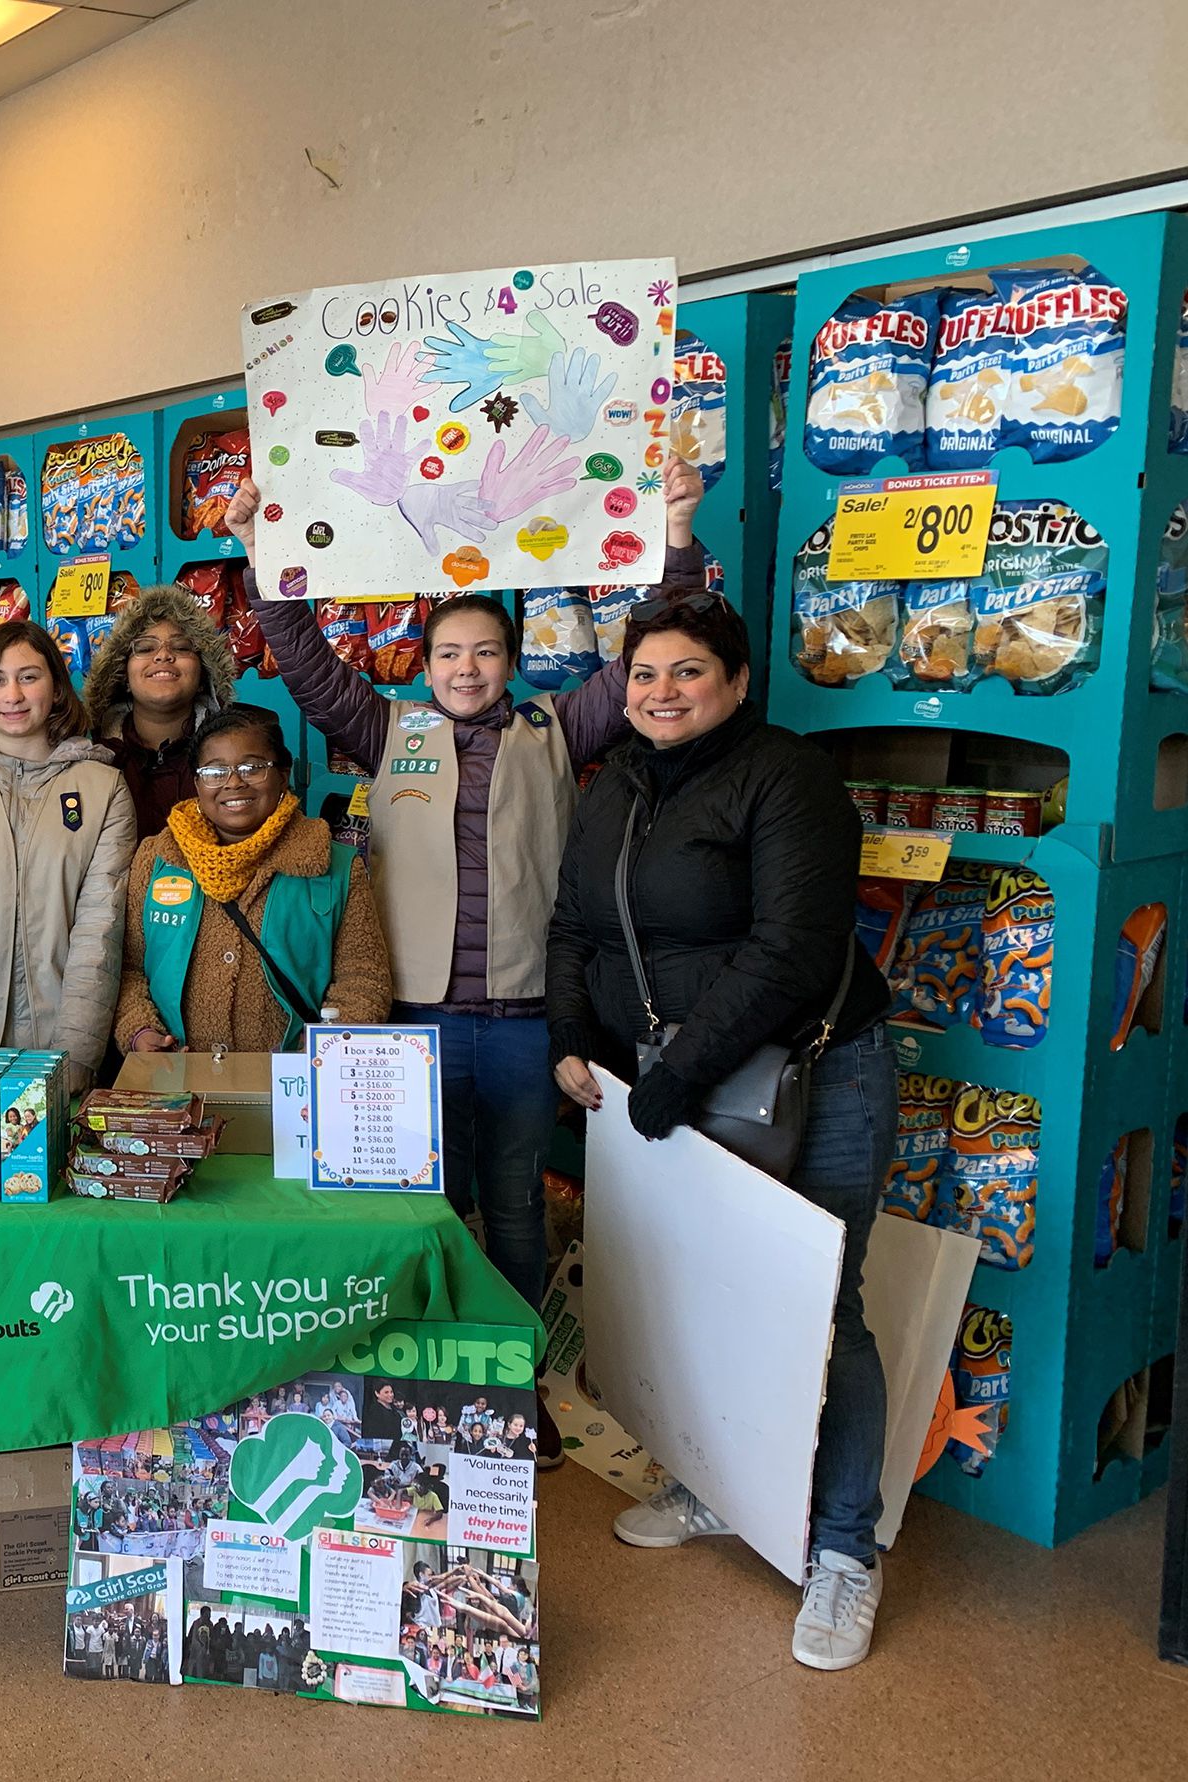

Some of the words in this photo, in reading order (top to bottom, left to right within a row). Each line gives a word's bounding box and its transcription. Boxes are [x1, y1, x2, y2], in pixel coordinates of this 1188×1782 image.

[322, 285, 471, 340] Cookies
[534, 267, 603, 310] Sale
[816, 312, 928, 360] RUFFLES
[1028, 350, 1063, 373] Party
[1063, 340, 1088, 357] Size!
[837, 363, 867, 382] Party
[867, 358, 893, 374] Size!
[950, 364, 977, 382] Party
[978, 354, 1003, 371] Size!
[608, 409, 632, 418] WOW!
[1030, 428, 1093, 444] ORIGINAL
[828, 436, 886, 453] ORIGINAL
[940, 436, 996, 453] ORIGINAL
[201, 453, 247, 477] Doritos
[888, 478, 921, 490] BONUS
[923, 476, 959, 487] TICKET
[960, 474, 985, 485] ITEM
[842, 497, 889, 514] Sale!
[59, 567, 76, 578] Sale!
[985, 582, 1033, 610] Party
[1039, 574, 1092, 597] Size!
[862, 834, 886, 846] ale!
[318, 1035, 341, 1055] LOVE
[351, 1047, 367, 1055] box
[376, 1046, 400, 1056] $4.00
[404, 1035, 428, 1055] LOVE
[368, 1059, 390, 1067] $8.00
[350, 1068, 356, 1077] 3
[365, 1070, 394, 1078] $12.00
[367, 1081, 392, 1089] $16.00
[350, 1091, 356, 1100] 5
[365, 1092, 395, 1101] $20.00
[367, 1104, 392, 1112] $24.00
[367, 1115, 393, 1123] $28.00
[367, 1125, 393, 1134] $32.00
[367, 1136, 393, 1144] $36.00
[370, 1146, 396, 1155] $40.00
[370, 1156, 396, 1165] $44.00
[318, 1161, 343, 1184] LOVE
[352, 1167, 374, 1175] boxes
[381, 1167, 407, 1176] $48.00
[411, 1162, 435, 1185] LOVE
[117, 1272, 246, 1310] Thank
[252, 1275, 329, 1313] you
[343, 1274, 386, 1299] for
[145, 1320, 212, 1346] your
[217, 1293, 390, 1346] support!
[336, 1331, 535, 1386] COUTS
[493, 1475, 508, 1487] do
[509, 1479, 528, 1489] not
[466, 1488, 529, 1505] necessarily
[450, 1500, 477, 1511] have
[479, 1503, 498, 1514] the
[499, 1505, 528, 1519] time;
[467, 1516, 495, 1530] they
[497, 1519, 528, 1532] have
[29, 1540, 47, 1548] Scout
[210, 1530, 240, 1543] GIRL
[243, 1533, 285, 1548] SCOUT
[318, 1532, 349, 1545] GIRL
[352, 1536, 397, 1551] SCOUT
[463, 1530, 483, 1542] the
[3, 1549, 25, 1557] Cookie
[3, 1575, 22, 1587] girl
[22, 1572, 49, 1584] scout
[94, 1579, 125, 1599] Girl
[126, 1568, 167, 1589] Scou
